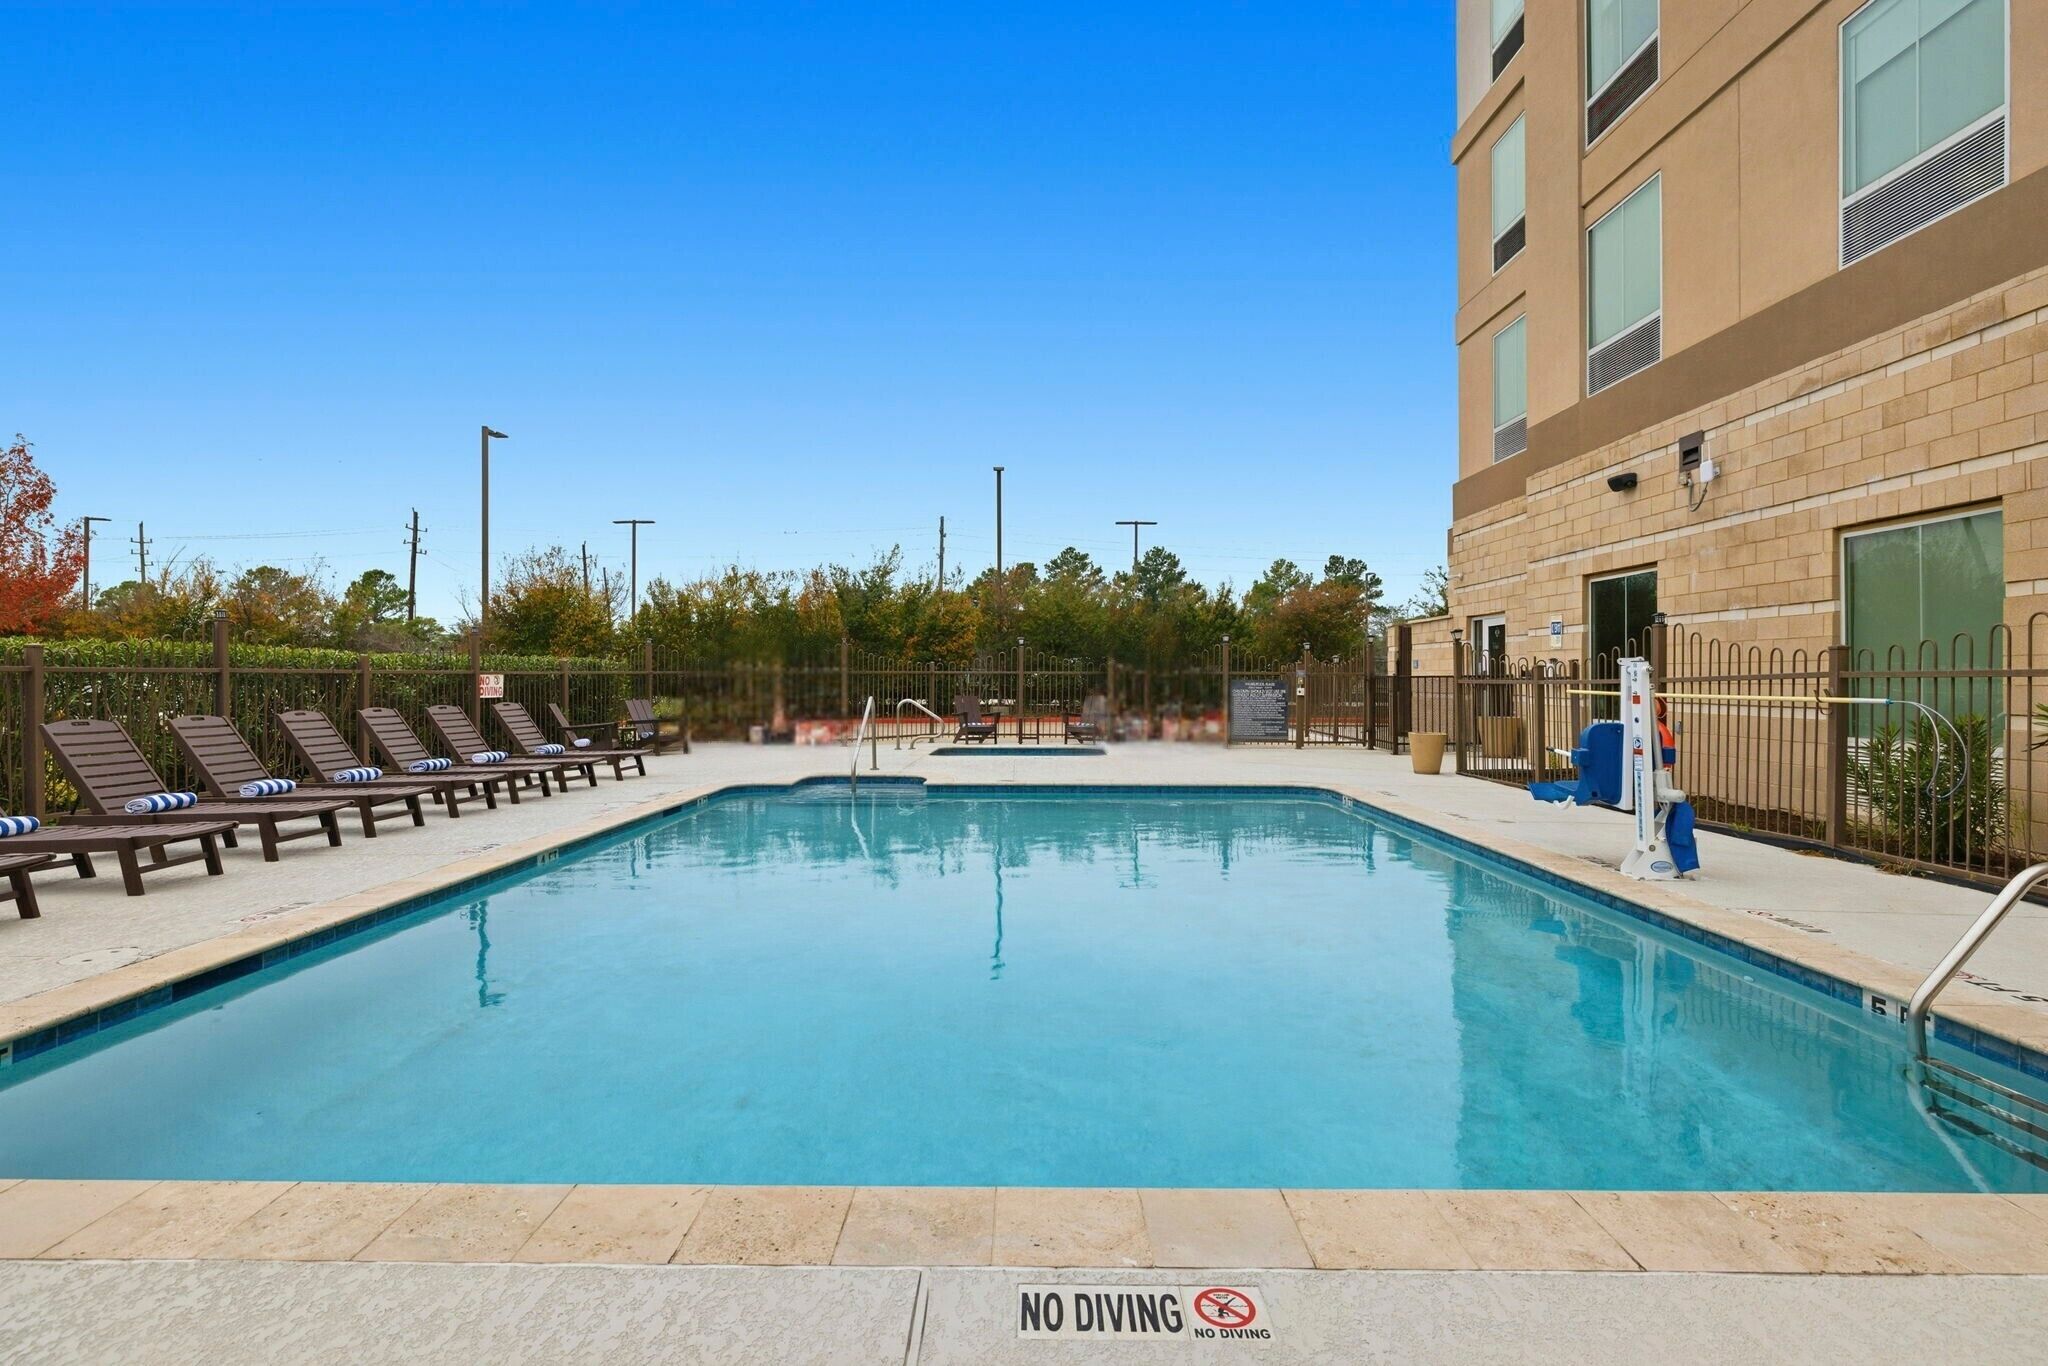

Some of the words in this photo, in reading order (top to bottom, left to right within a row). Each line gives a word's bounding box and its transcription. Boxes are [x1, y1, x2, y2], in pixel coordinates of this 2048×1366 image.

[479, 676, 490, 686] NO
[479, 686, 503, 696] DIVING
[1871, 995, 1887, 1016] 5
[1020, 1292, 1064, 1332] NO
[1074, 1293, 1184, 1334] DIVING
[1194, 1328, 1216, 1339] NO
[1219, 1328, 1271, 1340] DIVING
